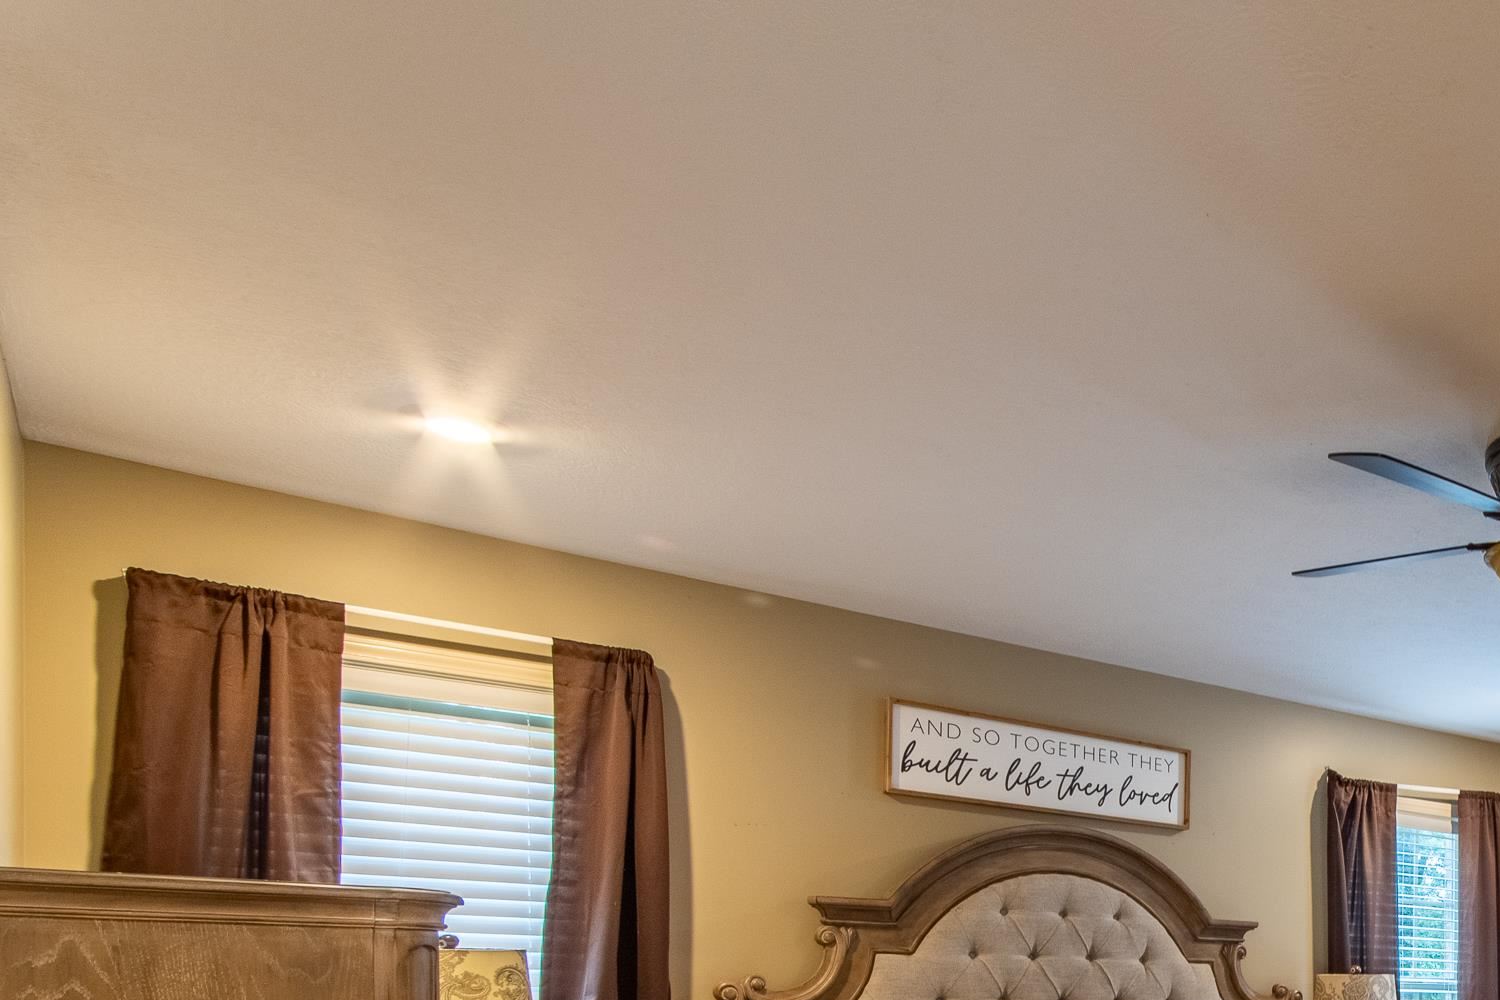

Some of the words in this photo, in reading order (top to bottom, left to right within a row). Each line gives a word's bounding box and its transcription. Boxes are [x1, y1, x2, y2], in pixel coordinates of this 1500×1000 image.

[900, 740, 978, 786] built
[980, 767, 998, 781] a
[1005, 758, 1052, 797] life
[1056, 766, 1113, 807] they
[1119, 775, 1179, 813] loved
[910, 717, 962, 740] AND
[972, 727, 1000, 746] SO
[1010, 733, 1119, 766] TOGETHER
[1128, 753, 1175, 773] THEY
